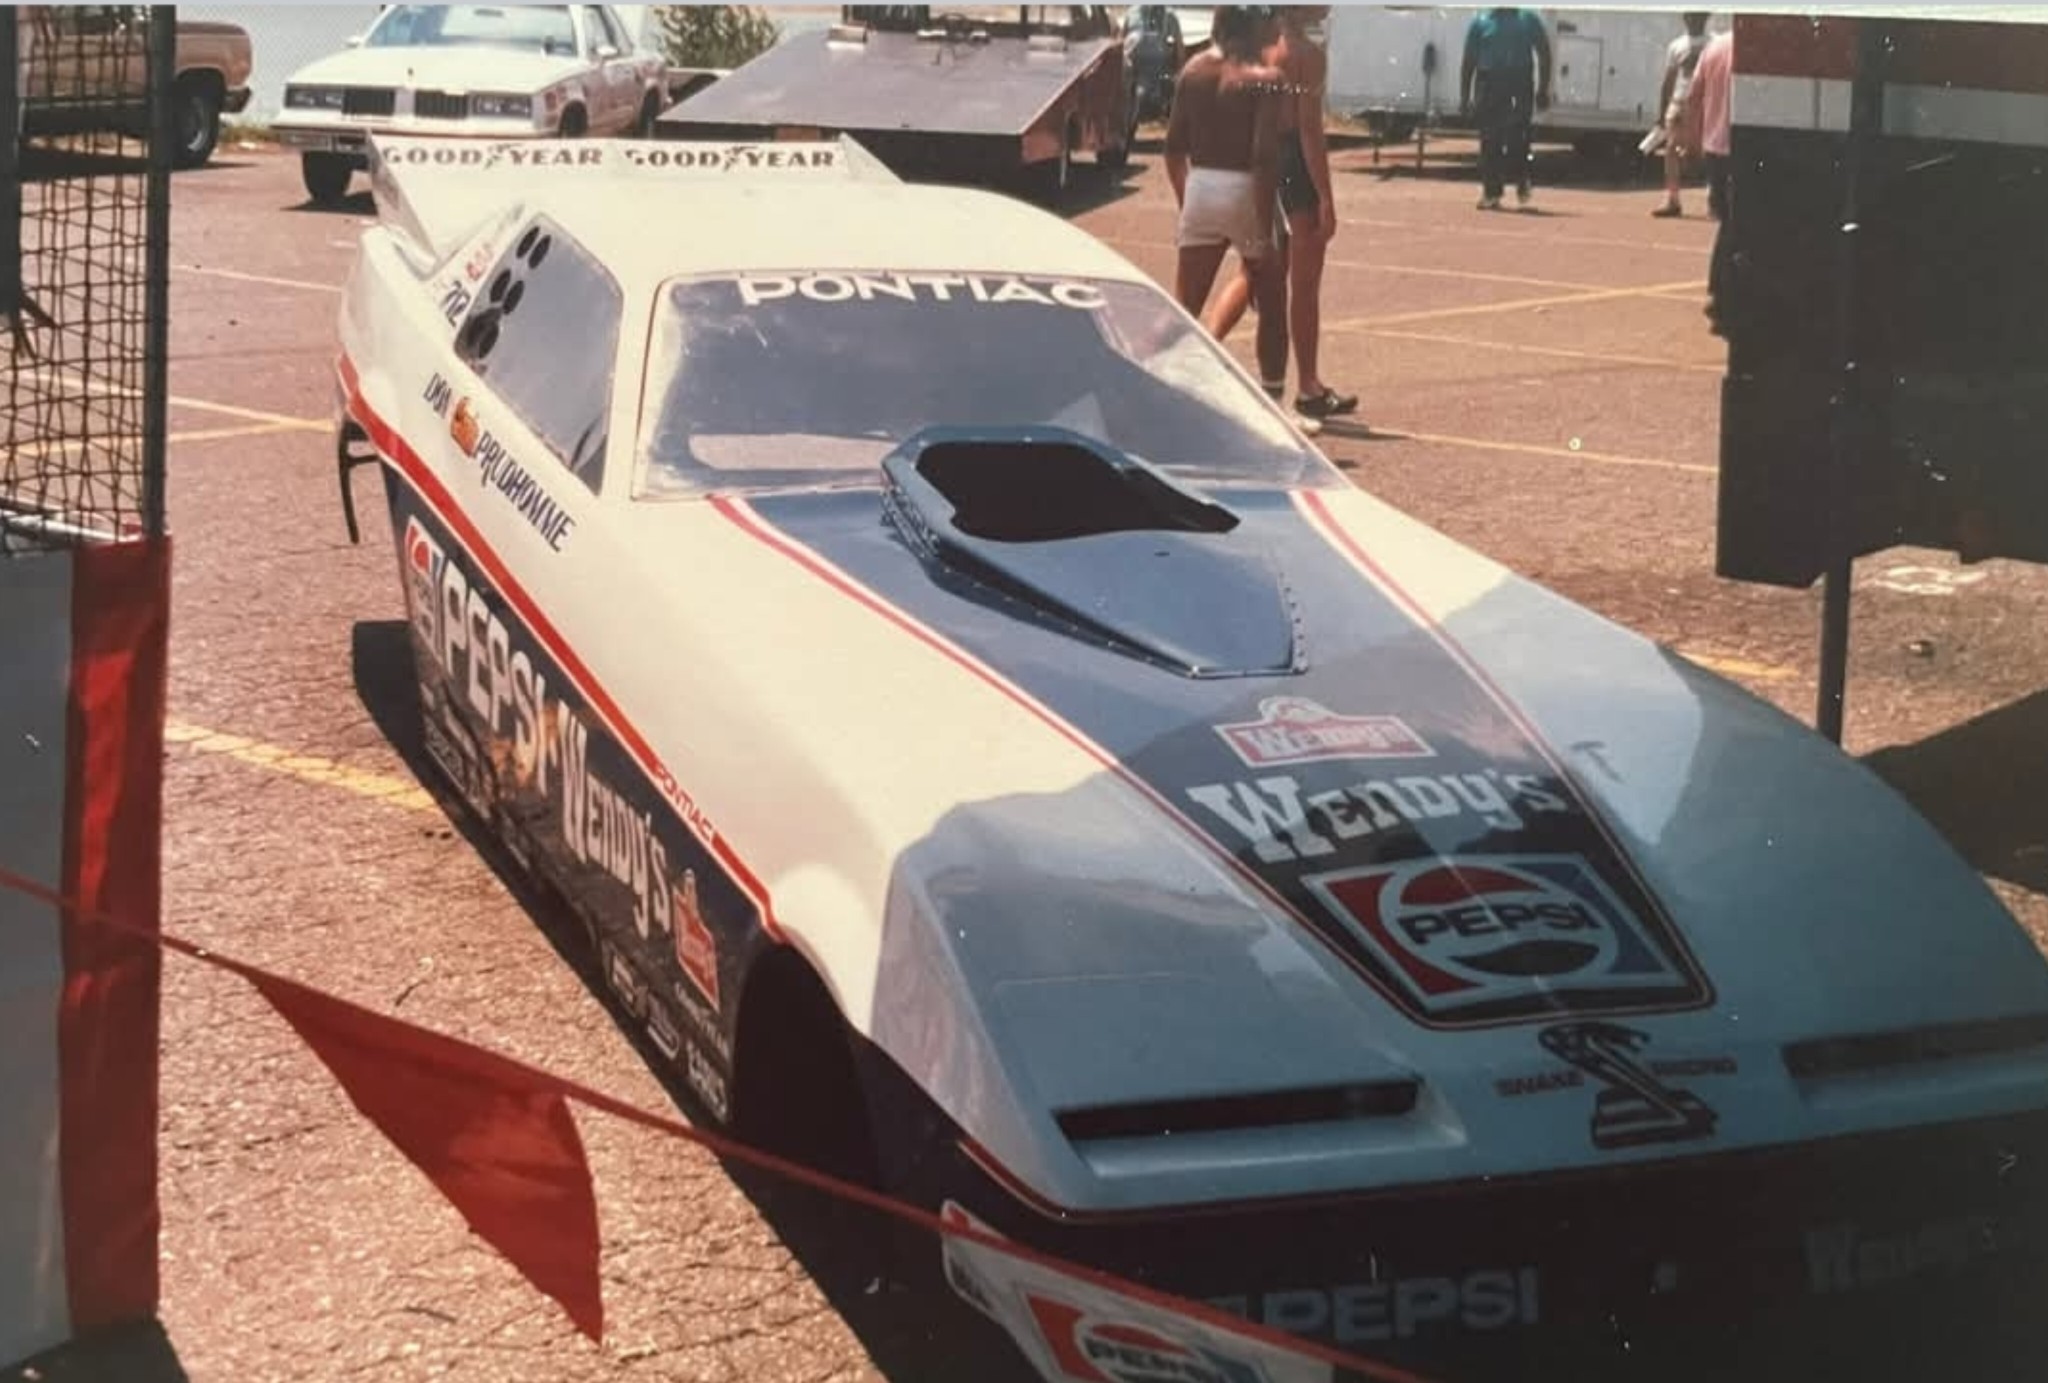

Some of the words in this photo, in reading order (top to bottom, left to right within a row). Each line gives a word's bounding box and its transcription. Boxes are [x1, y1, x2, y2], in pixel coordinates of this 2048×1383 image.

[737, 274, 1108, 309] PONTIAC
[423, 372, 452, 420] DON
[442, 559, 548, 797] PEPSI
[1397, 899, 1603, 946] PEPSI
[1262, 1263, 1540, 1344] PEPSI
